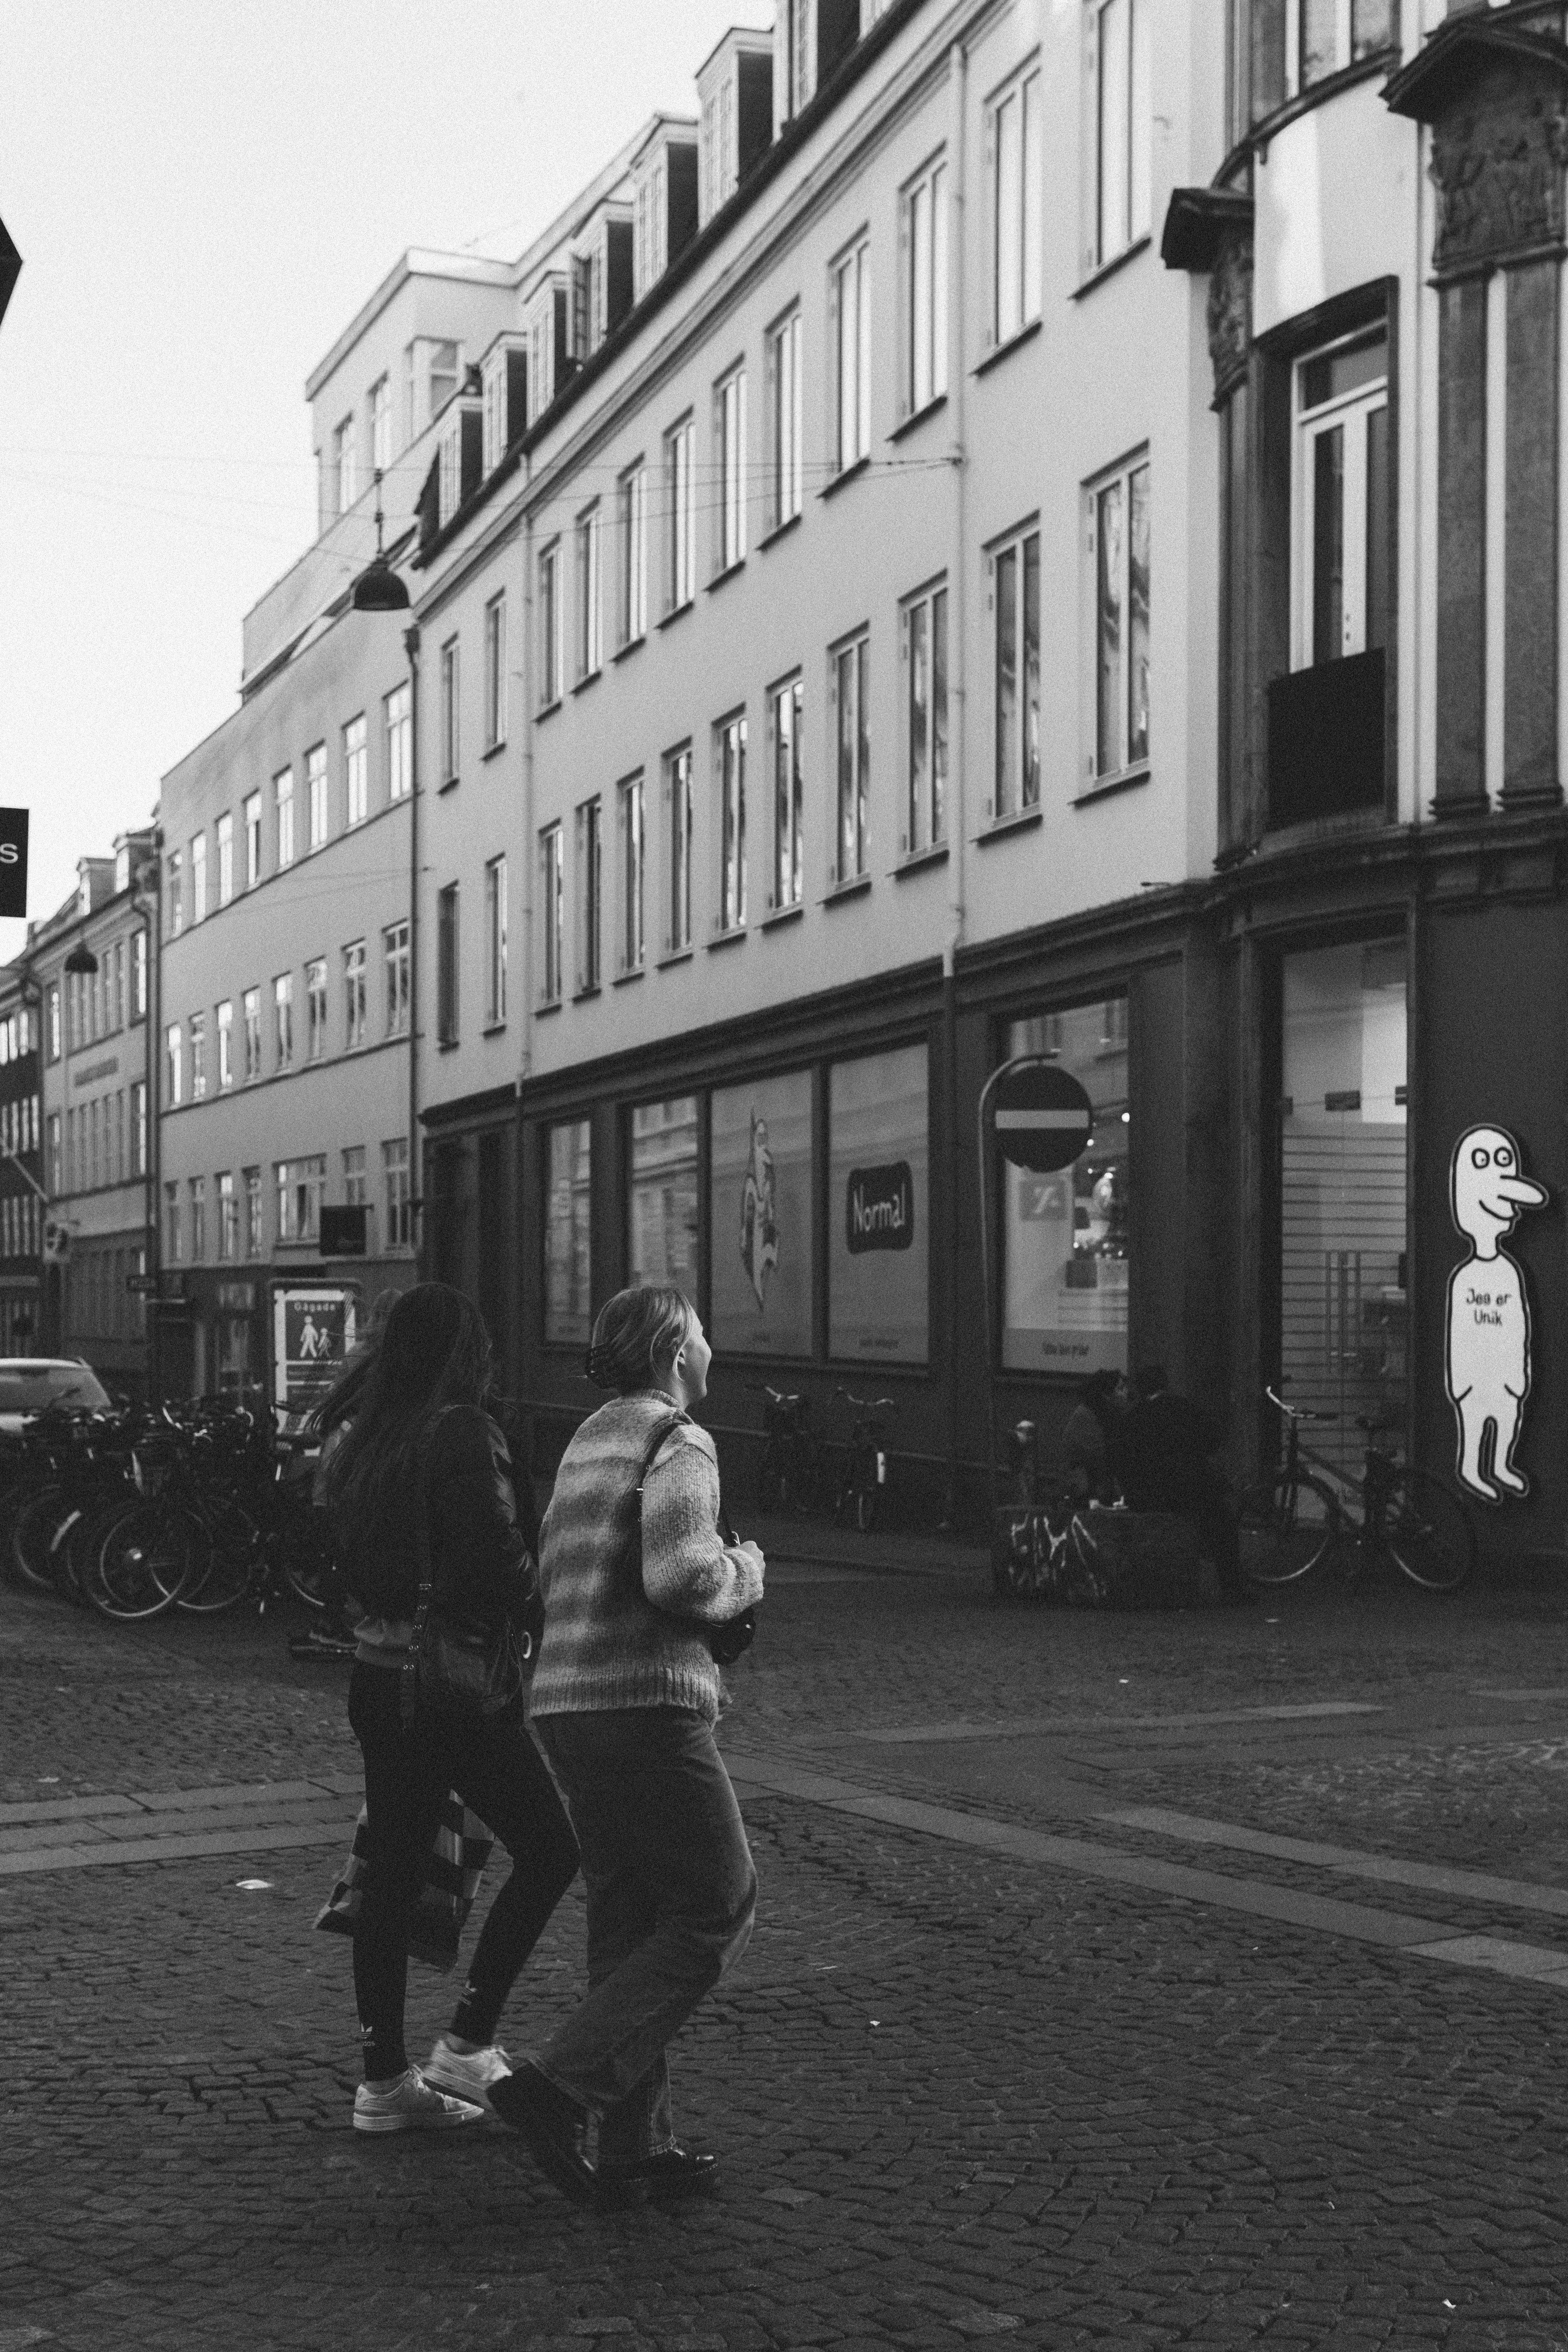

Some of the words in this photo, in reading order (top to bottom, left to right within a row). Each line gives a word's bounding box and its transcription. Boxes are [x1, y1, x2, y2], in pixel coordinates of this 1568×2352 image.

[853, 1182, 906, 1234] Normal
[1496, 1294, 1512, 1306] er
[1474, 1309, 1503, 1326] Unik
